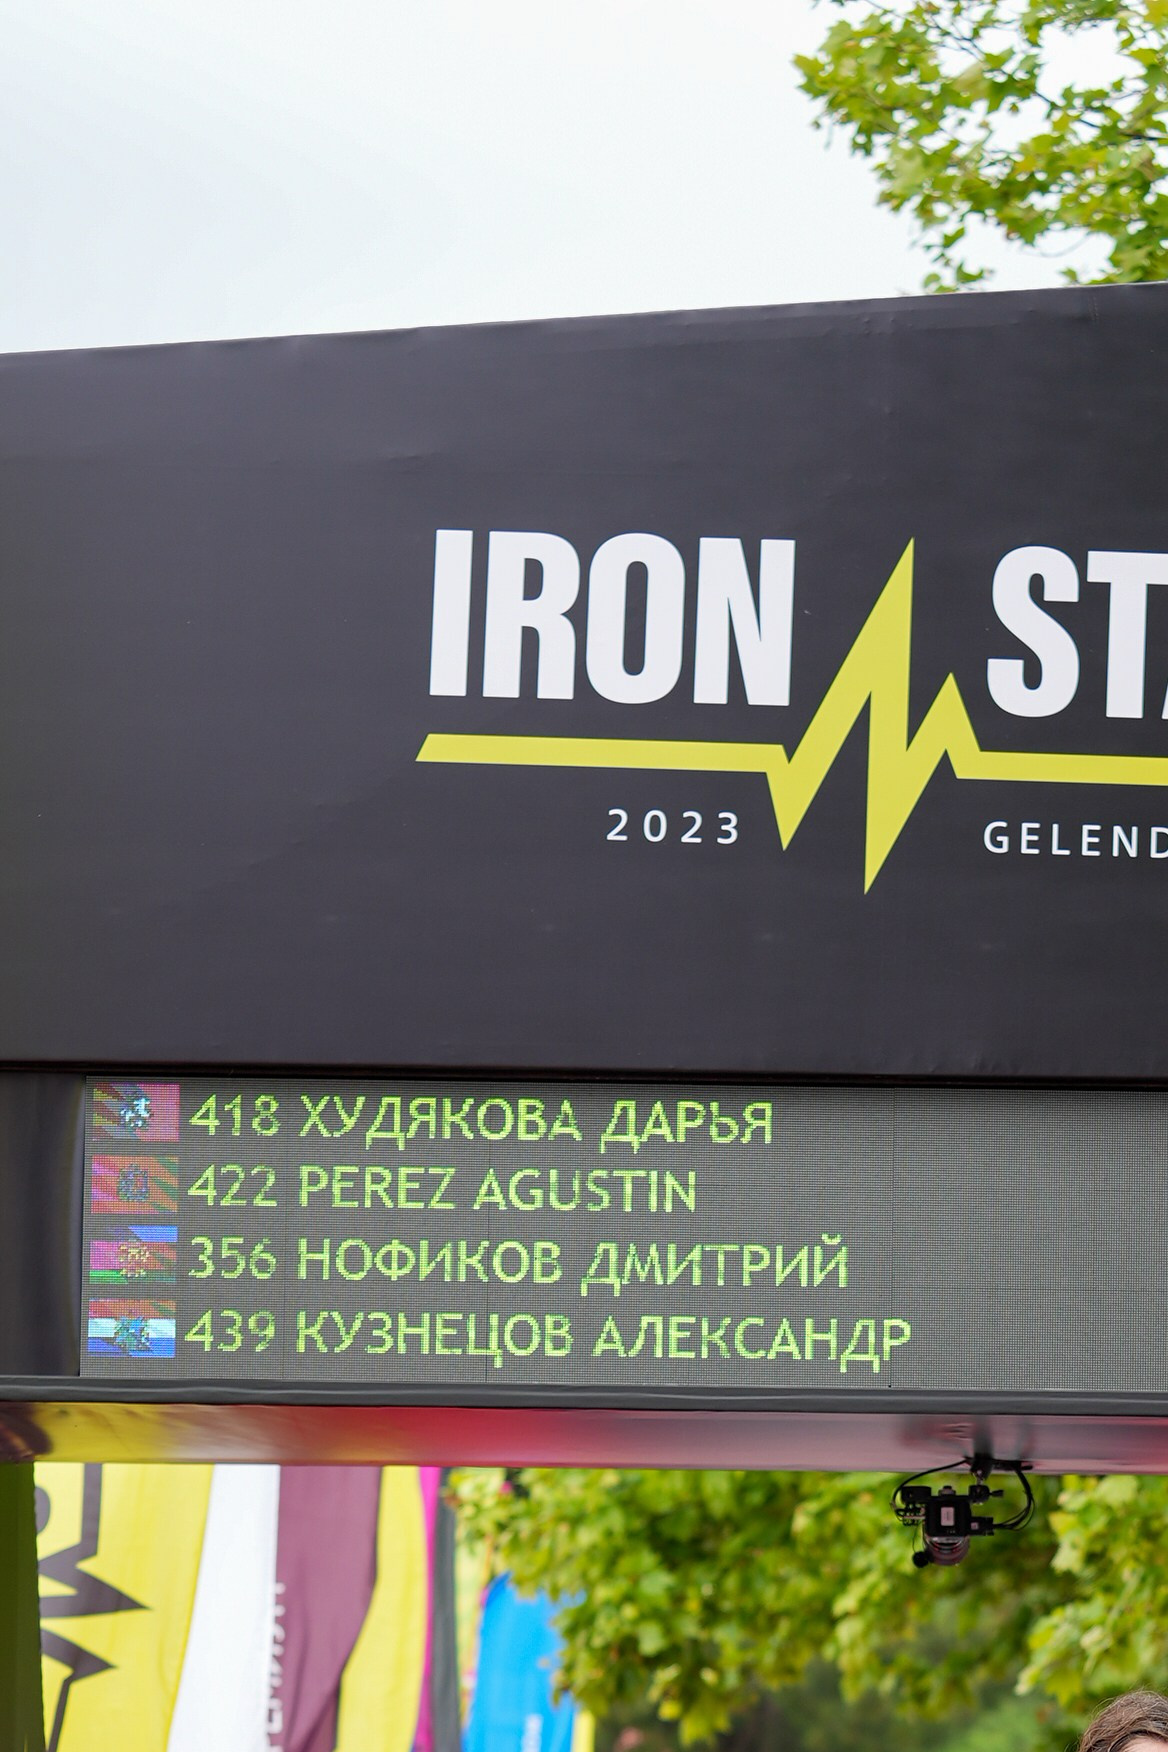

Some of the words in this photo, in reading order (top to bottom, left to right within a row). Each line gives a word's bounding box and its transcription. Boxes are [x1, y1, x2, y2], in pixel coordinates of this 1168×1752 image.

[428, 529, 797, 707] IRON
[605, 808, 741, 846] 2023
[189, 1095, 282, 1138] 418
[299, 1094, 583, 1150] ХУДЯКОВА
[600, 1100, 774, 1153] ДАРЬЯ
[188, 1164, 278, 1209] 422
[299, 1165, 456, 1209] PEREZ
[473, 1166, 697, 1213] AGUSTIN
[188, 1236, 277, 1281] 356
[298, 1235, 562, 1286] НОФИКОВ
[581, 1233, 849, 1296] ДМИТРИЙ
[184, 1309, 276, 1354] 439
[297, 1309, 573, 1369] КУЗНЕЦОВ
[592, 1314, 912, 1374] АЛЕКСАНДР
